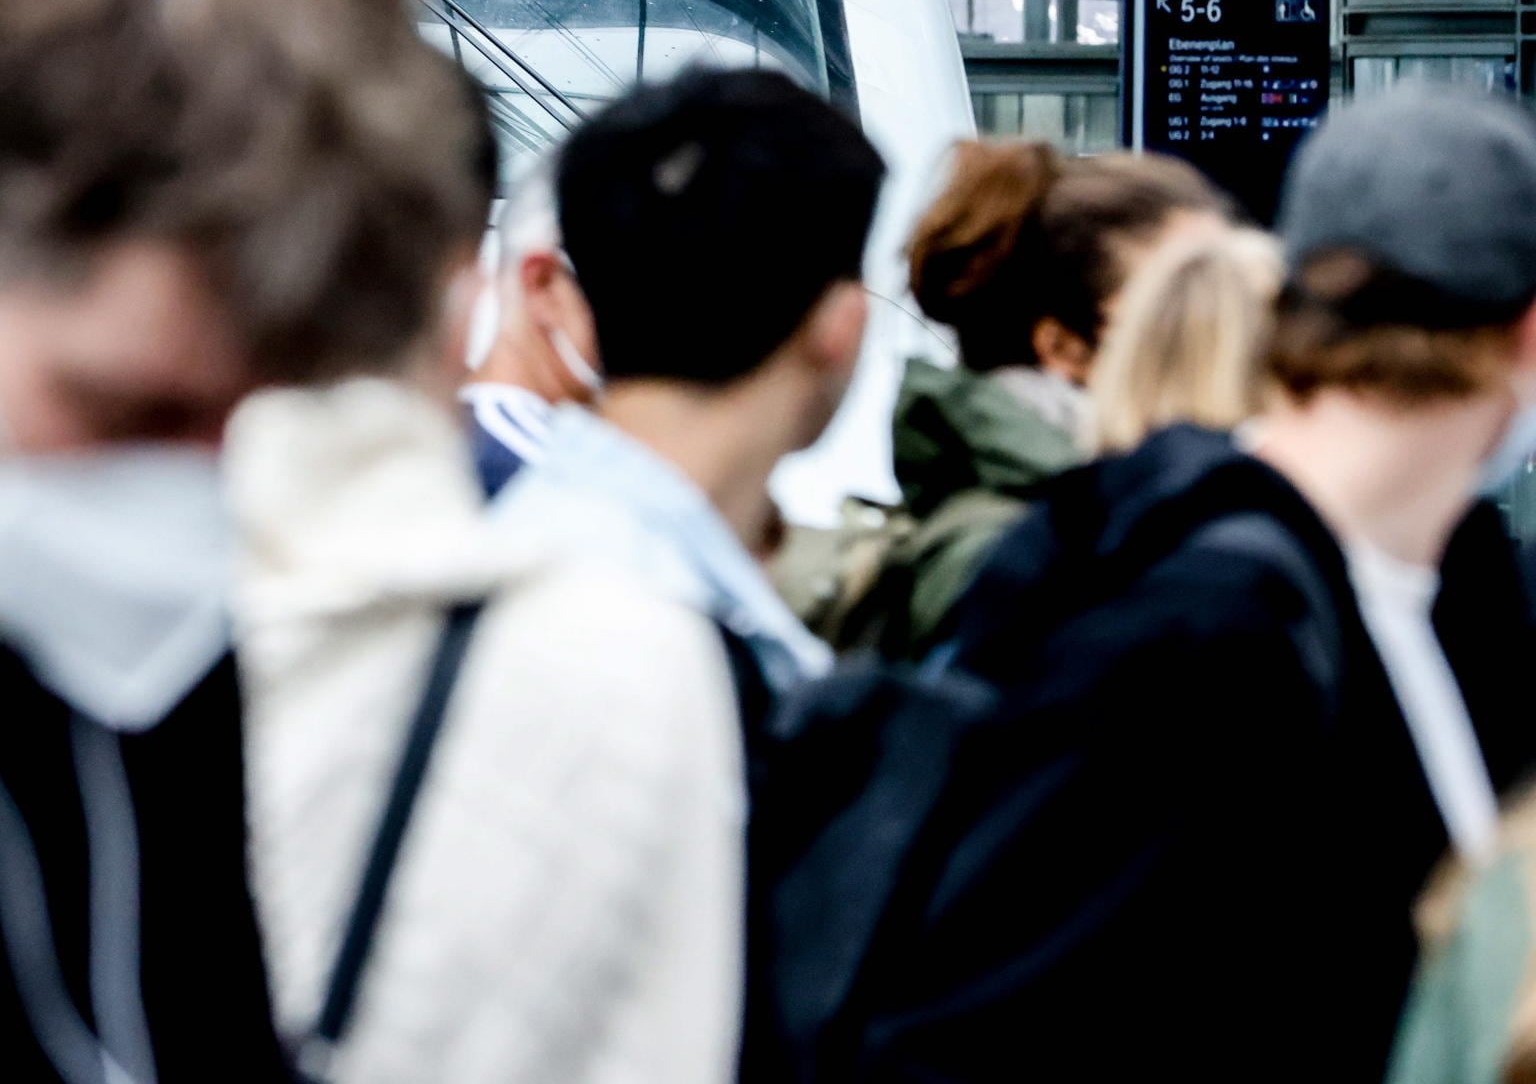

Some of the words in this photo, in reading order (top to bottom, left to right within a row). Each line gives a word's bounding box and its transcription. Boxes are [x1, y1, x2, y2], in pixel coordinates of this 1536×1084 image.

[1168, 37, 1235, 53] Ebenenplan
[1200, 78, 1232, 90] Zugang
[1200, 92, 1237, 104] Ausgang
[1200, 116, 1232, 128] Zugang
